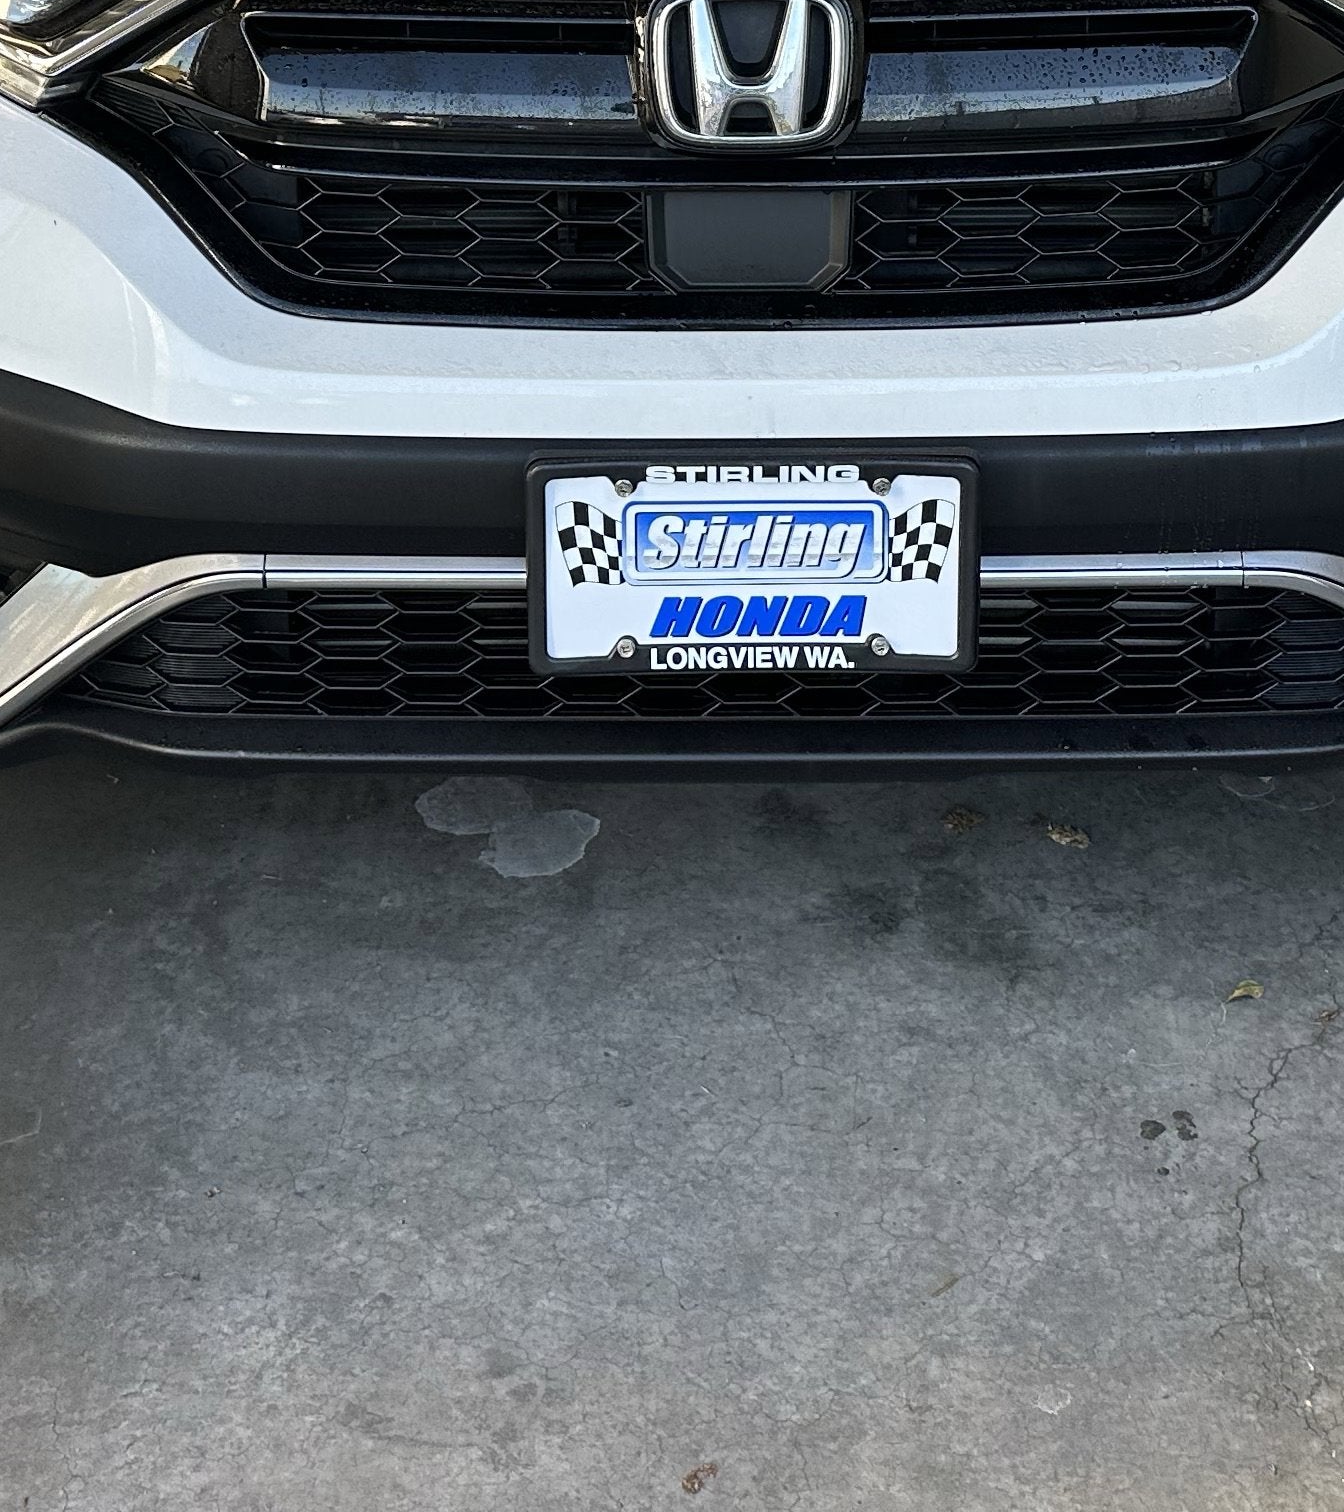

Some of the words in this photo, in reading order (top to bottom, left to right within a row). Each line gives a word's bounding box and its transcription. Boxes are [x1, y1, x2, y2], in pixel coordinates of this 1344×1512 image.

[645, 465, 861, 484] STIRLING
[644, 514, 866, 579] Stirling
[649, 595, 868, 638] HONDA
[650, 646, 799, 670] LONGVIEW
[801, 646, 855, 670] WA.
